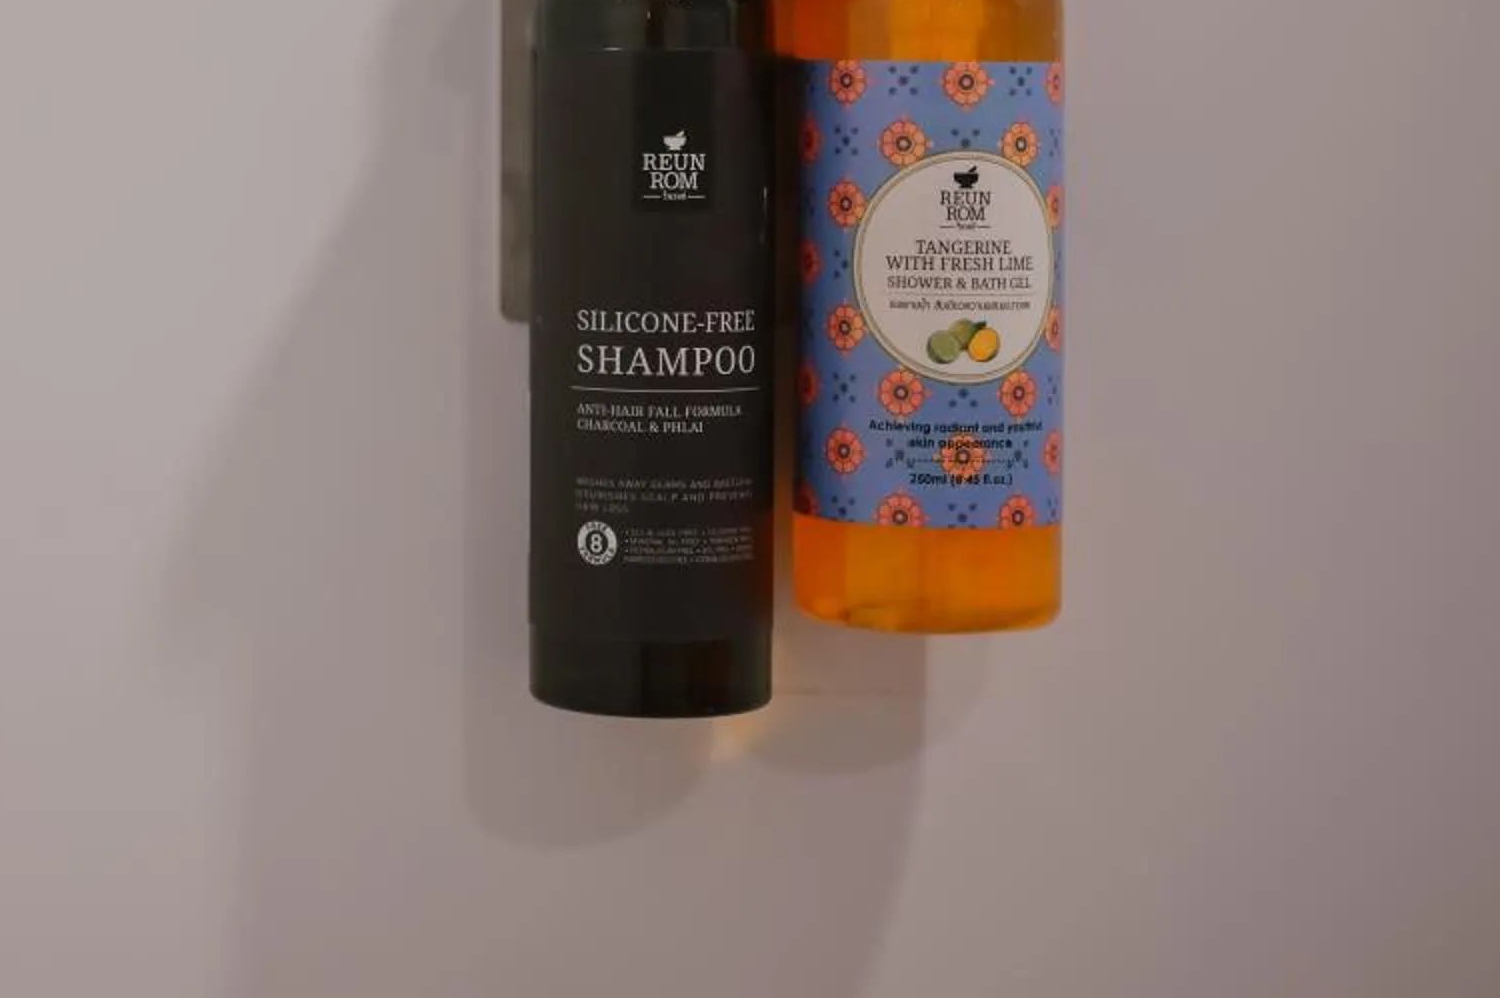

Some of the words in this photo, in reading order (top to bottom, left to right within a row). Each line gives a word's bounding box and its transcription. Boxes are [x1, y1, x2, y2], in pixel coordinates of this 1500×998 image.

[642, 153, 706, 171] REUN
[649, 171, 699, 190] ROM
[939, 190, 992, 205] REUN
[946, 205, 986, 221] ROM
[915, 239, 1012, 255] TANGERINE
[886, 255, 934, 271] WITH
[940, 255, 994, 271] FRESH
[999, 255, 1034, 271] LIME
[887, 275, 953, 289] SHOWER
[955, 277, 966, 289] &
[971, 277, 1007, 290] BATH
[1009, 277, 1032, 289] GEL
[576, 309, 755, 333] SILICONE-FREE
[577, 344, 755, 376] SHAMPOO
[576, 403, 644, 418] ANTI-HAIR
[649, 404, 681, 418] FALL
[685, 403, 741, 418] FORMULA
[576, 418, 644, 433] CHARCOAL
[649, 421, 659, 433] &
[663, 421, 704, 433] PHLAI
[869, 419, 931, 435] Achieving
[933, 420, 978, 433] radiant
[981, 420, 1005, 433] and
[907, 436, 934, 449] skin
[938, 437, 1013, 451] appearance
[591, 534, 603, 553] 8
